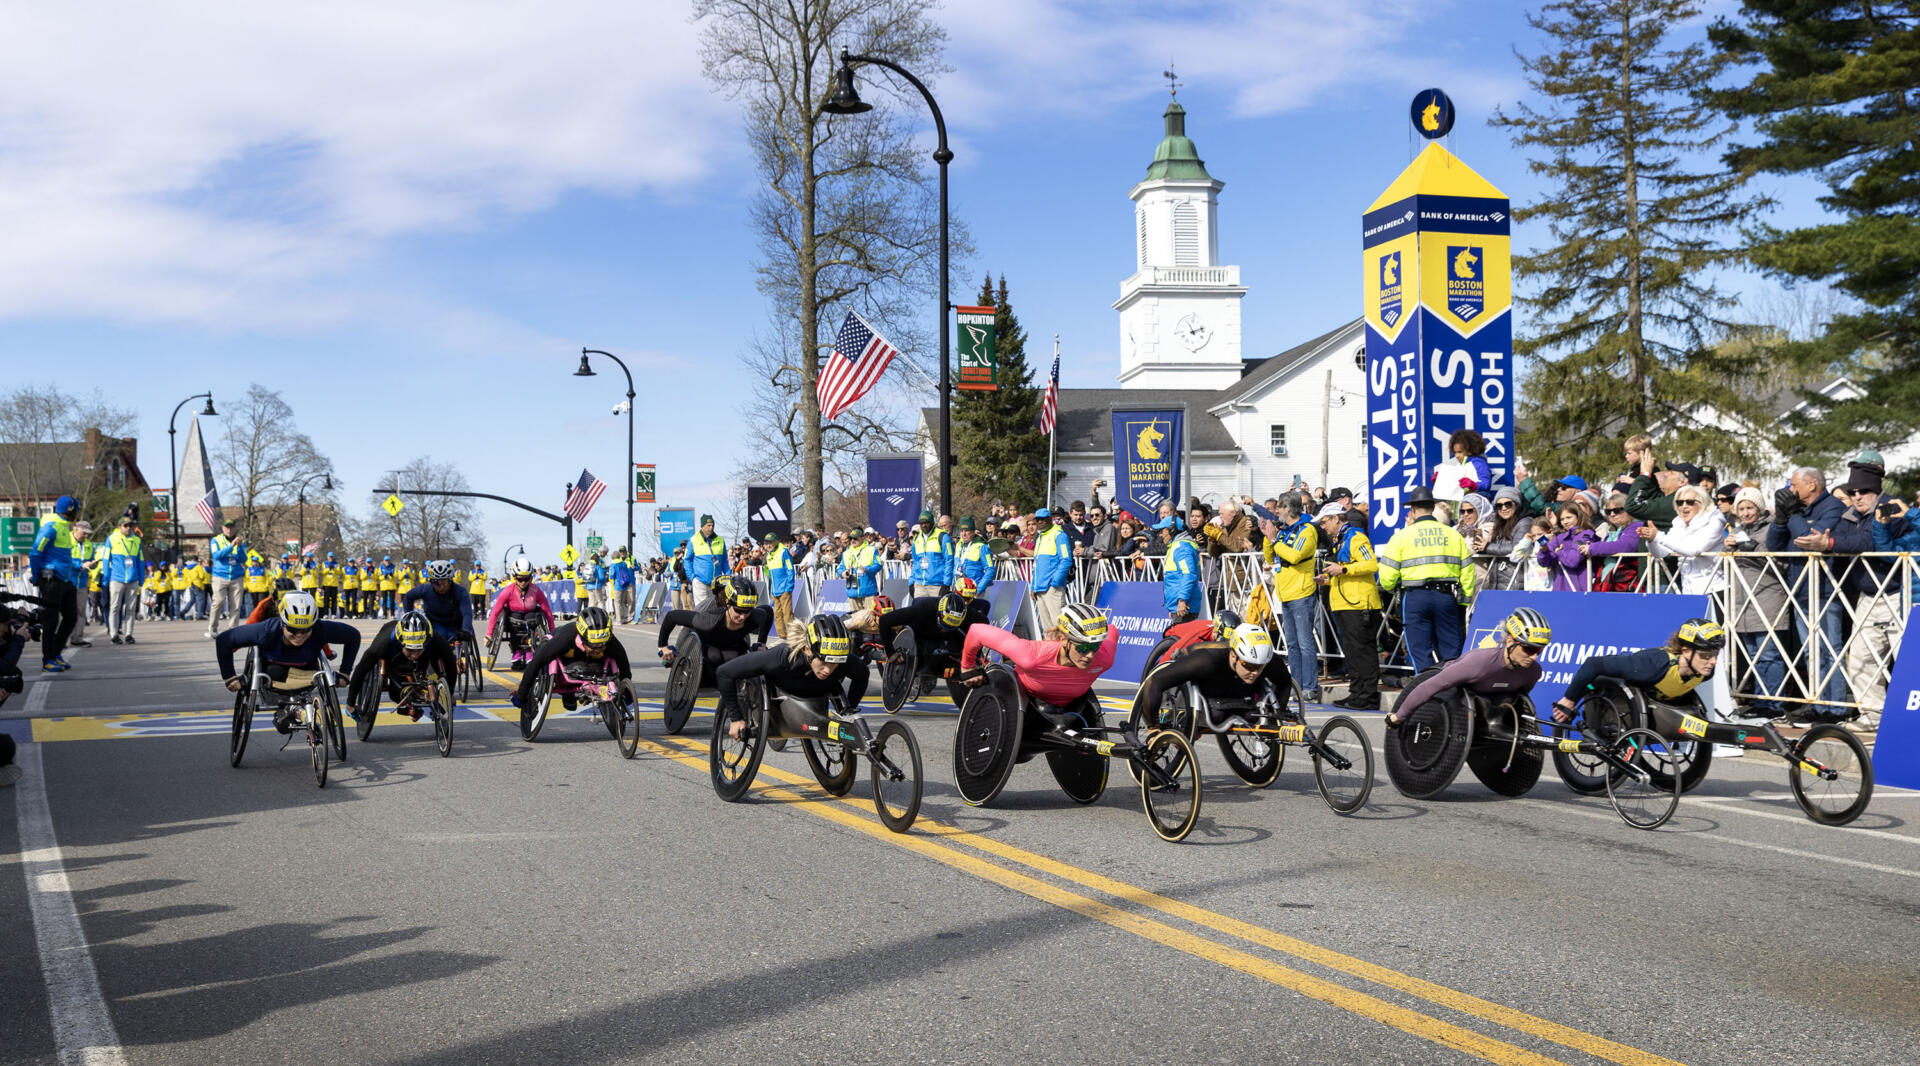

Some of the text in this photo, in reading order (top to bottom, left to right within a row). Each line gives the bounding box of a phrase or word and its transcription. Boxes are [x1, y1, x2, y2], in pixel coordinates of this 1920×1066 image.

[1443, 212, 1453, 220] OF
[1454, 213, 1489, 222] AMERICA
[1364, 228, 1377, 238] BANK
[1383, 217, 1405, 231] AMERICA
[1448, 280, 1482, 290] BOSTON
[1380, 284, 1401, 298] BOSTON
[1448, 289, 1482, 297] MARATHON
[957, 314, 995, 326] HOPKINTON
[1480, 352, 1505, 491] HOPKIN
[1131, 462, 1169, 473] BOSTON
[1418, 527, 1443, 537] STATE
[1414, 537, 1448, 547] POLICE
[1111, 616, 1142, 631] BOSTON
[822, 641, 829, 650] DE
[1121, 636, 1130, 644] OF
[1129, 637, 1154, 646] AMERICA
[1540, 642, 1576, 664] TON
[1683, 718, 1705, 733] W104
[1280, 727, 1300, 741] W101
